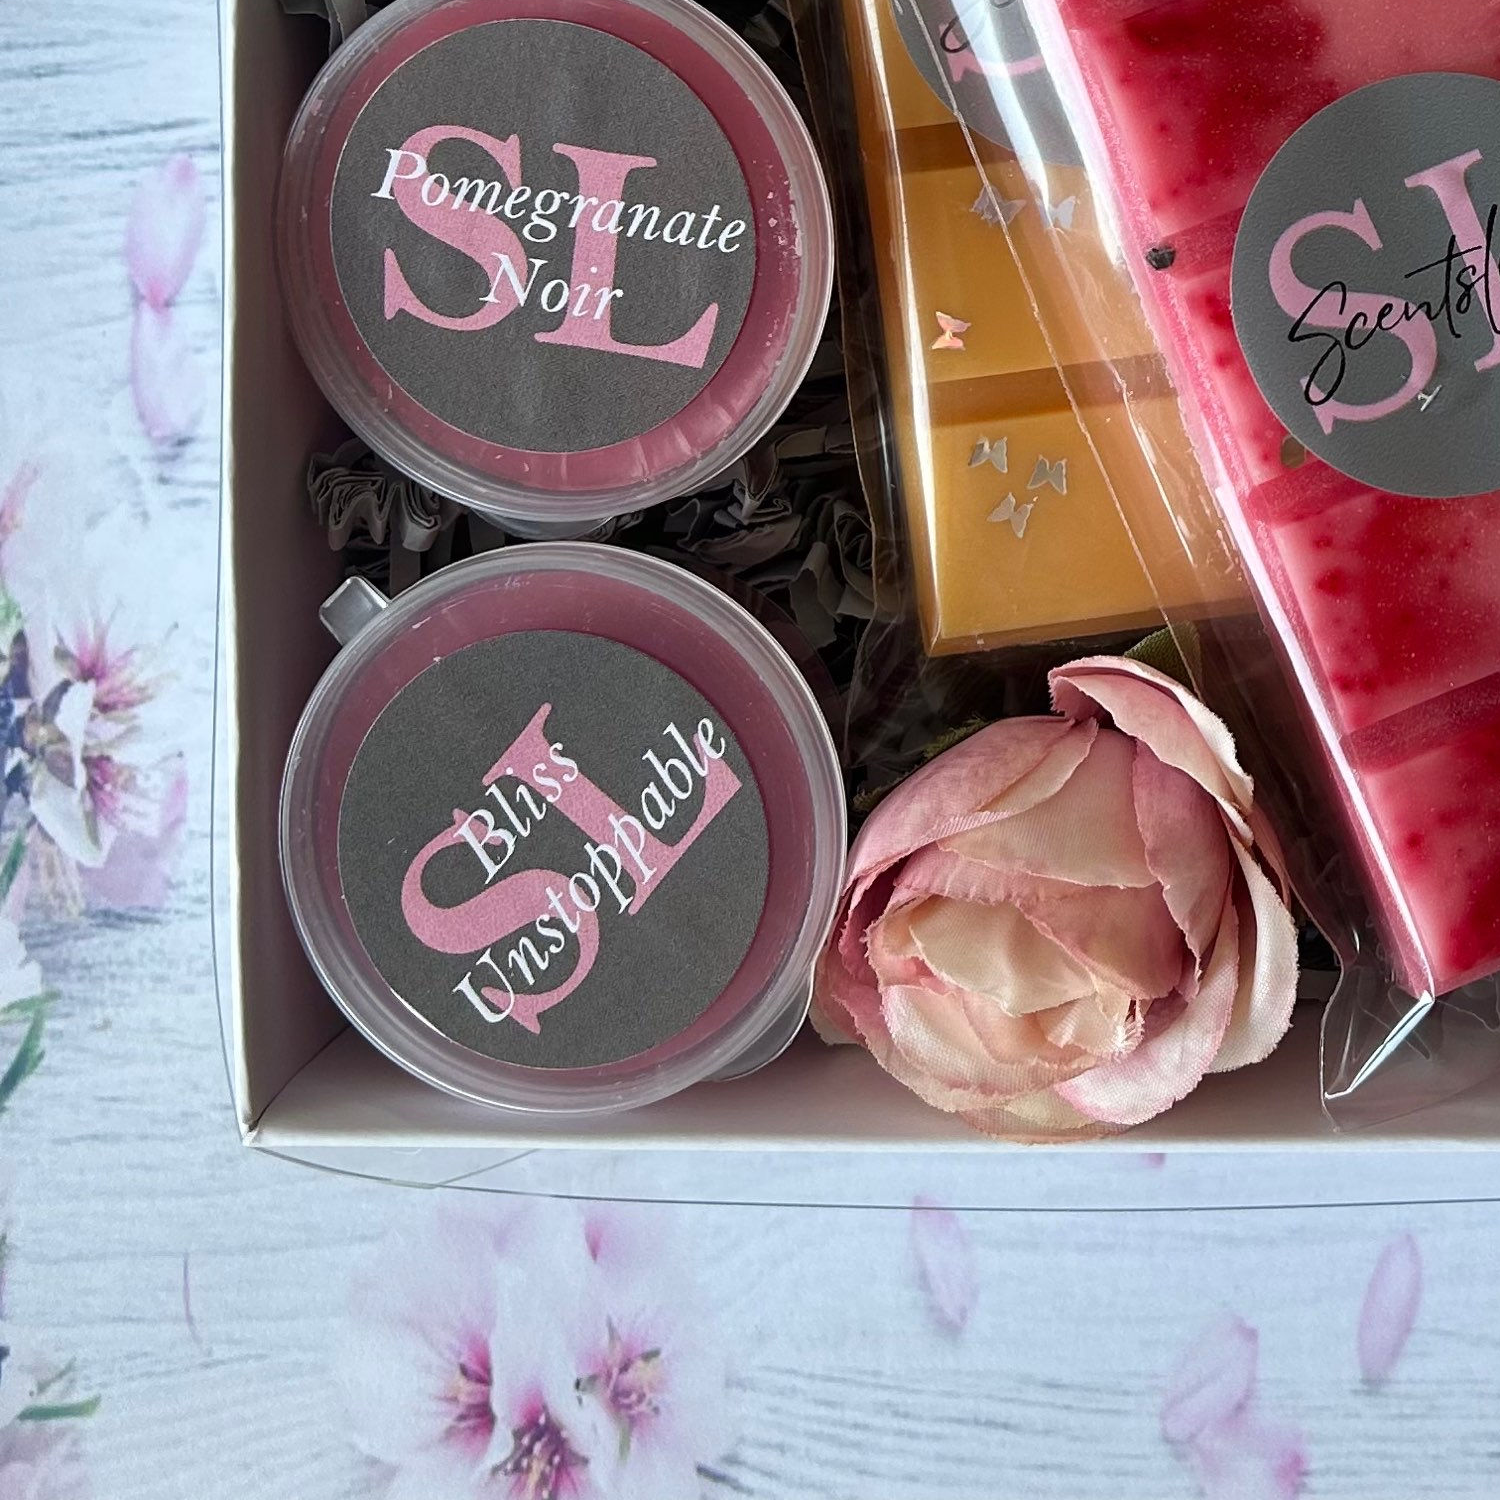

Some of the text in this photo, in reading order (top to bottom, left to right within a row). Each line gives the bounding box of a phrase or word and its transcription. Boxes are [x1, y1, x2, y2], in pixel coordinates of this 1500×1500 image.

[370, 147, 748, 254] Pomegranate
[382, 124, 720, 369] SL
[478, 251, 625, 322] Noir
[450, 715, 727, 1024] Unstoppable
[452, 740, 580, 885] Bliss
